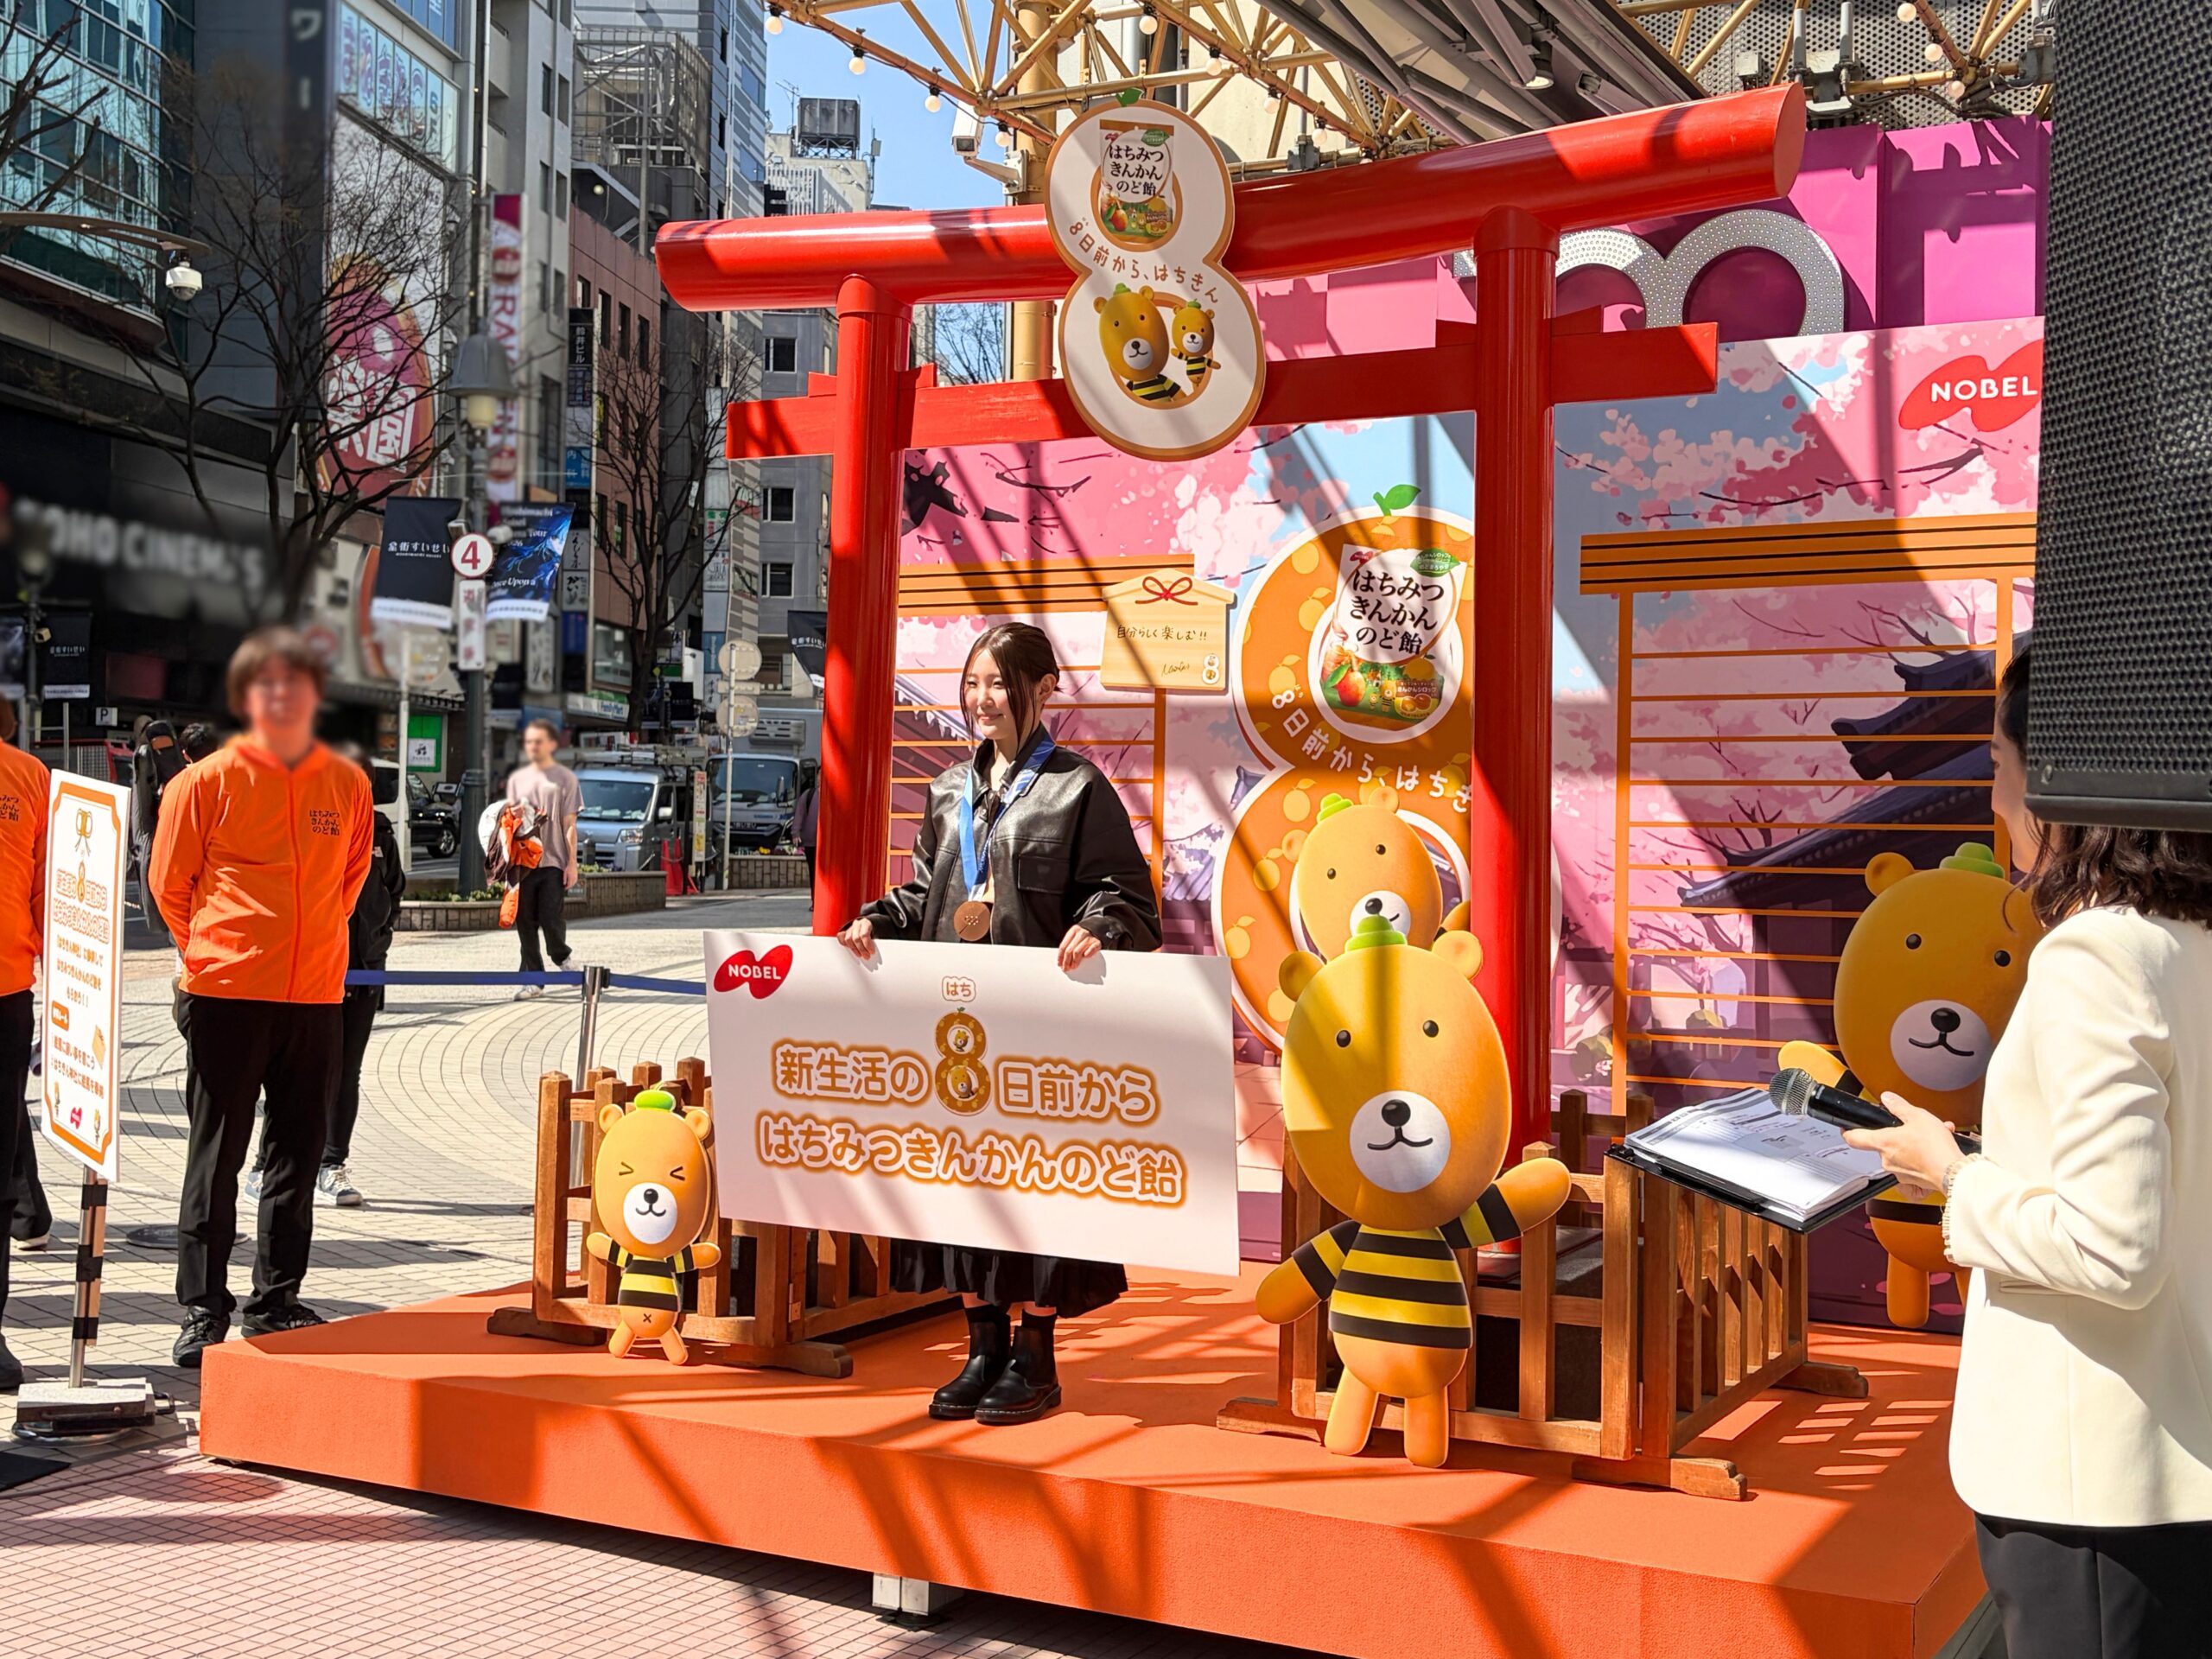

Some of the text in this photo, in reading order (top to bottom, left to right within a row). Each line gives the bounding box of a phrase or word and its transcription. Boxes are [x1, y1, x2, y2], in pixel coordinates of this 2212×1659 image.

[1109, 144, 1164, 162] はちみつ
[1110, 162, 1163, 181] きんかん
[1116, 181, 1156, 196] のど飴
[1069, 221, 1218, 303] 8日前から、はちきん
[1930, 375, 2038, 403] NOBEL
[461, 540, 481, 570] 4
[1352, 569, 1445, 602] はちみつ
[1350, 597, 1438, 631] きんかん
[1356, 627, 1423, 655] のど飴
[100, 708, 109, 718] P
[309, 809, 340, 818] はちみつ
[728, 963, 781, 980] NOBEL
[946, 982, 971, 997] はち
[760, 1120, 1179, 1198] はちみつきんかんのど飴
